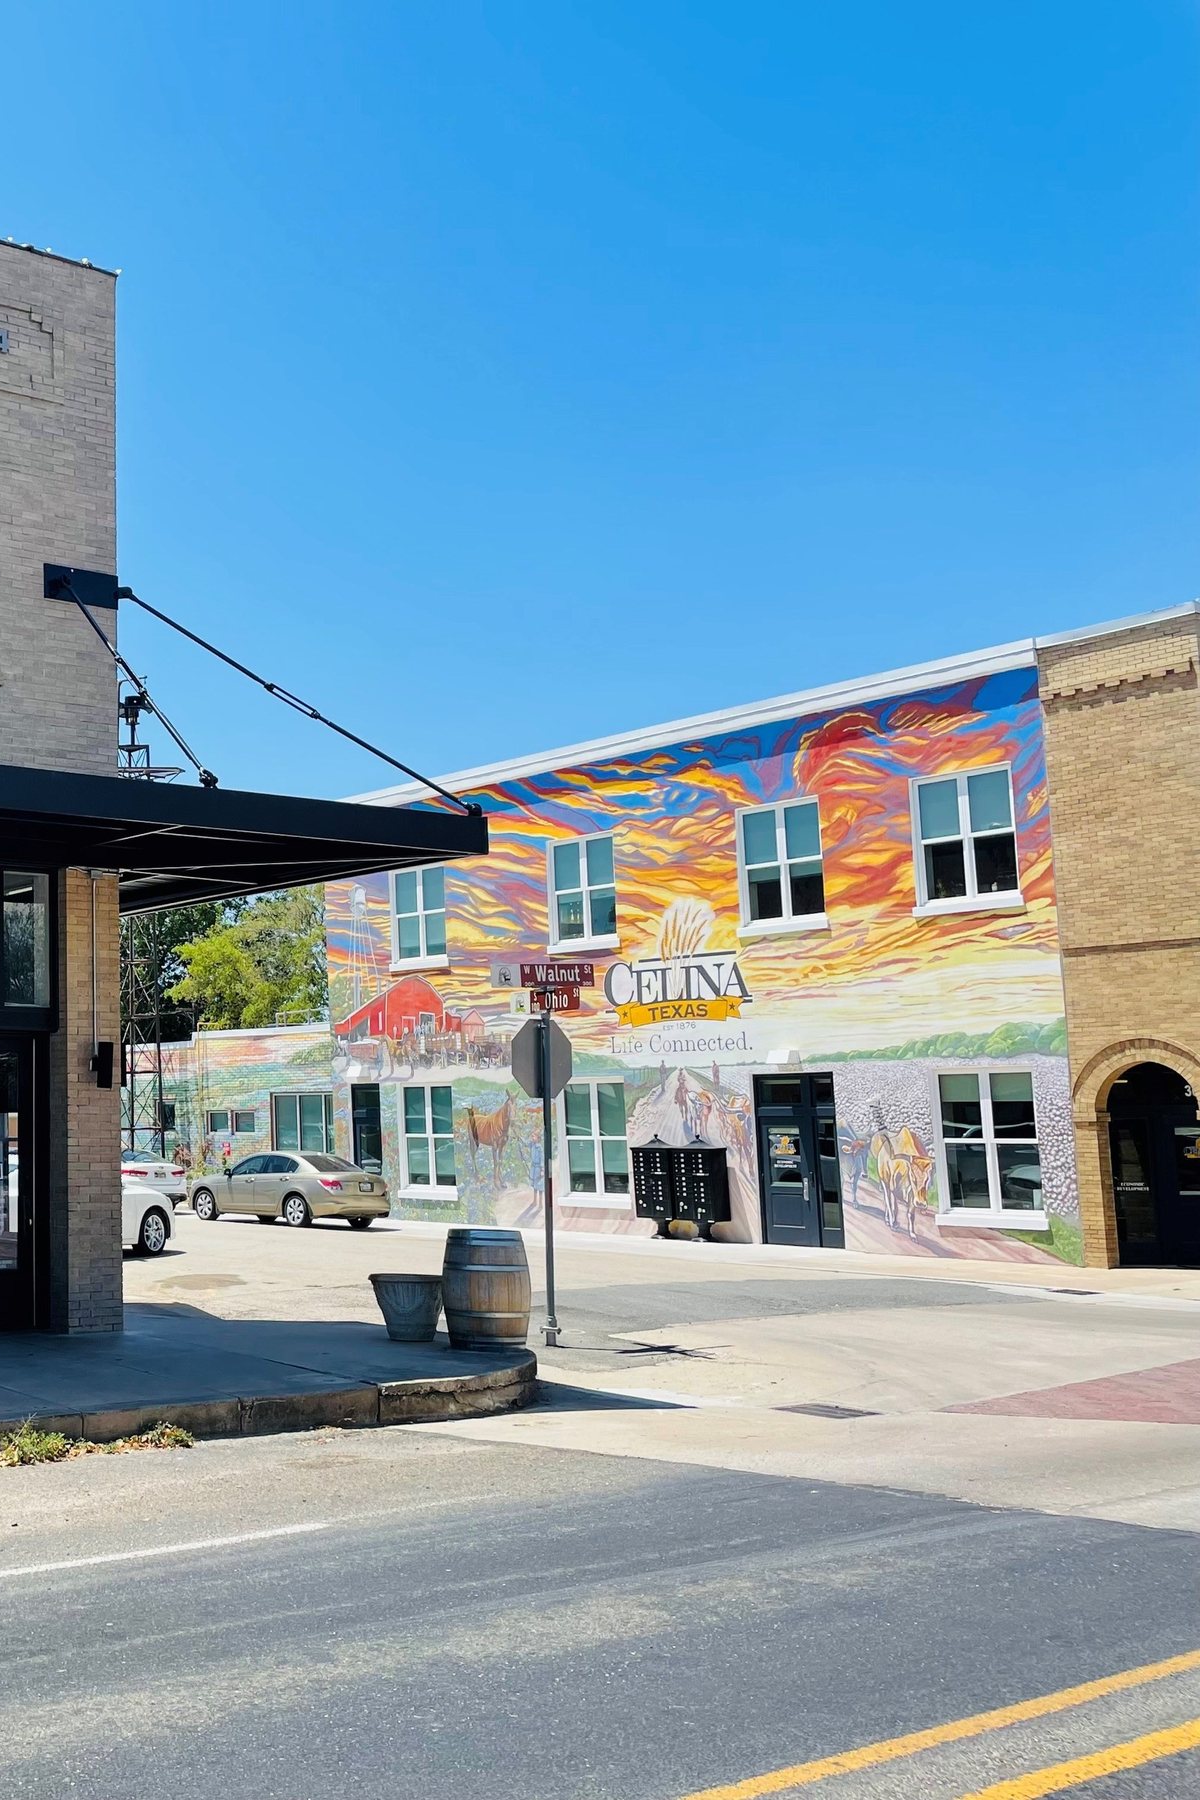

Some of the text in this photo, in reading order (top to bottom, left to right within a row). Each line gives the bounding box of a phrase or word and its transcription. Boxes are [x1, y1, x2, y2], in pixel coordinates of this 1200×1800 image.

[523, 965, 592, 982] W Walnut St
[604, 961, 750, 1006] CELINA
[533, 988, 580, 1009] S Ohio St
[648, 1003, 708, 1021] TEXAS
[676, 1022, 696, 1030] 1876
[610, 1031, 753, 1054] Life Connected.
